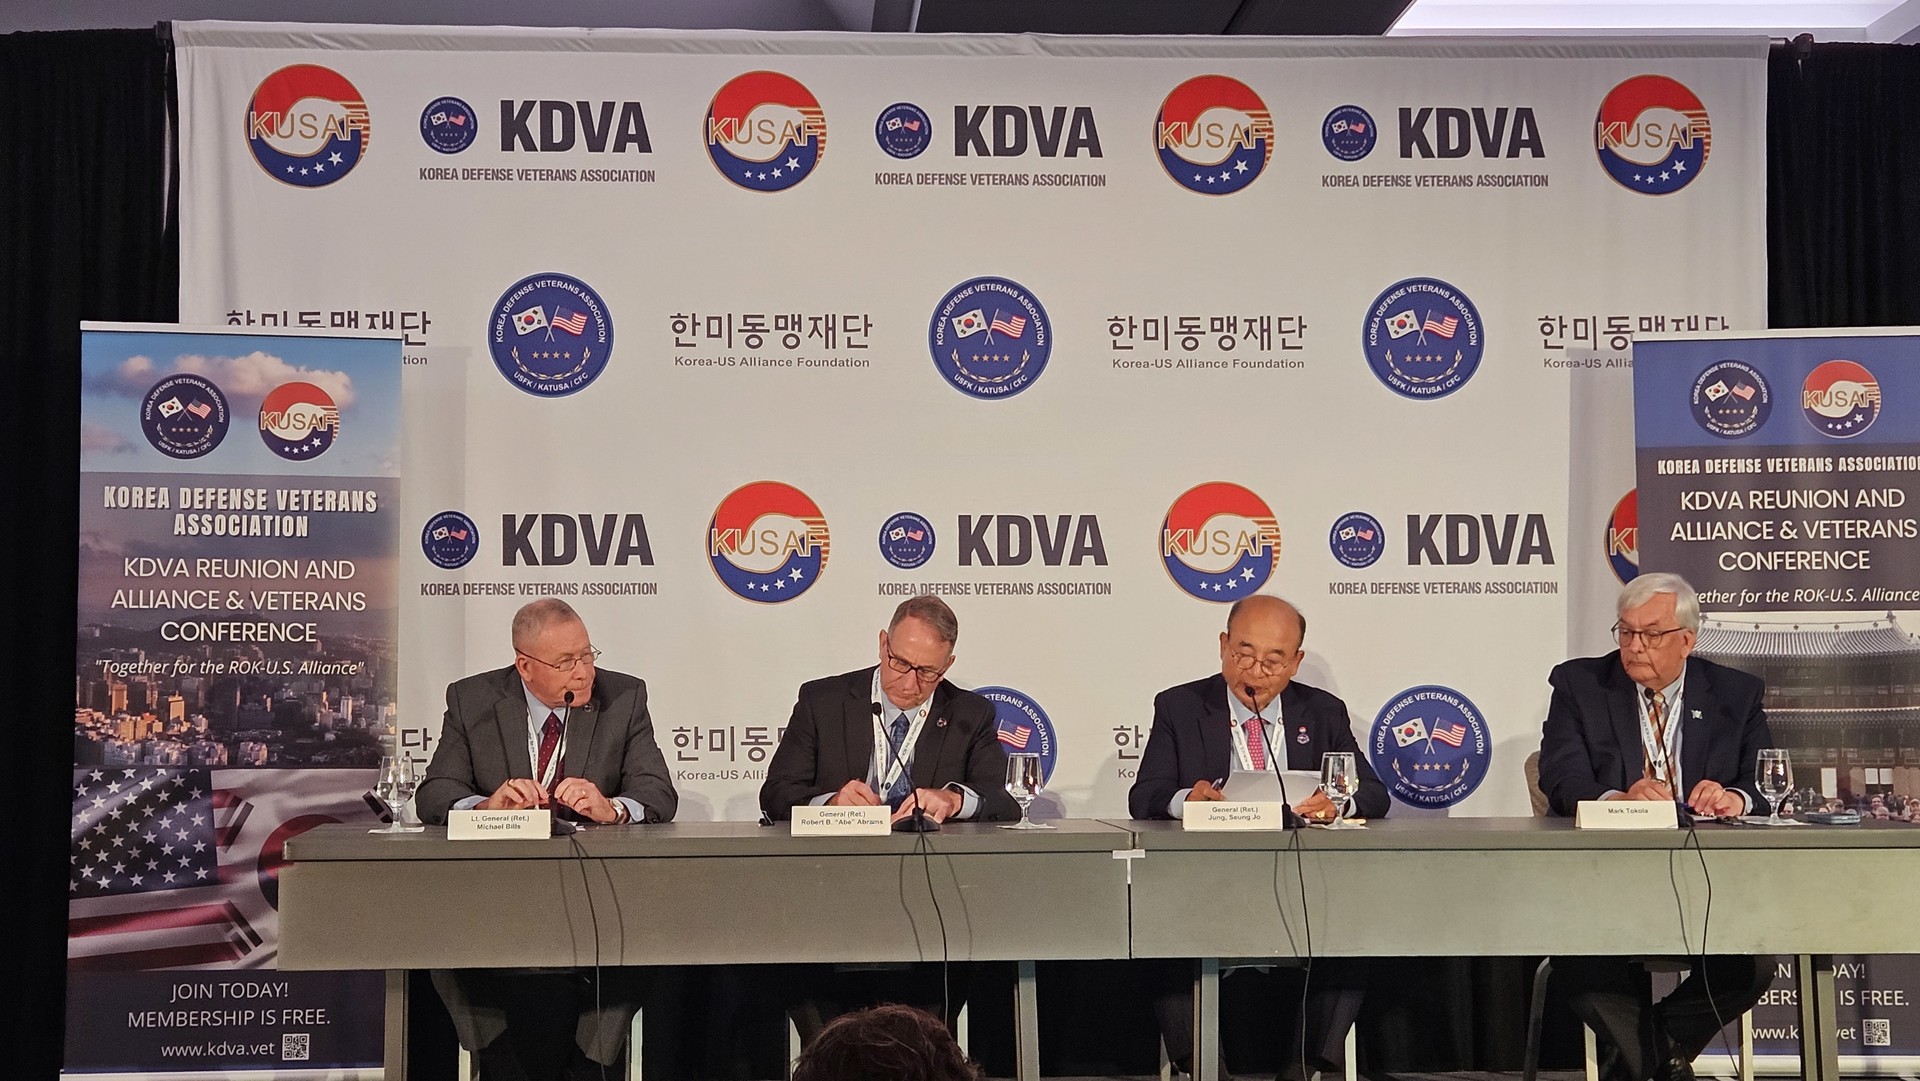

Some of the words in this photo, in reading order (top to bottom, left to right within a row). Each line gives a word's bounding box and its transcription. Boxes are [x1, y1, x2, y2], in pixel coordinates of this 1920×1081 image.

[250, 111, 364, 141] KUSAF
[500, 100, 652, 153] KDVA
[708, 117, 821, 147] KUSAF
[954, 105, 1103, 158] KDVA
[1158, 121, 1268, 150] KUSAF
[1399, 107, 1545, 158] KDVA
[1598, 121, 1706, 150] KUSAF
[420, 168, 459, 180] KOREA
[462, 168, 513, 181] DEFENSE
[516, 169, 577, 181] VETERANS
[580, 169, 655, 182] ASSOCIATION
[875, 173, 913, 185] KOREA
[917, 173, 967, 185] DEFENSE
[970, 173, 1029, 186] VETERANS
[1032, 174, 1106, 187] ASSOCIATION
[1322, 175, 1359, 187] KOREA
[1363, 175, 1412, 187] DEFENSE
[1415, 175, 1473, 187] VETERANS
[1476, 174, 1548, 187] ASSOCIATION
[496, 312, 507, 343] KOREA
[502, 284, 535, 313] DEFENSE
[534, 280, 580, 294] VETERANS
[577, 289, 606, 343] ASSOCIATION
[936, 315, 947, 346] KOREA
[942, 287, 974, 316] DEFENSE
[973, 284, 1018, 298] VETERANS
[1016, 293, 1044, 346] ASSOCIATION
[1370, 316, 1381, 347] KOREA
[1376, 289, 1407, 318] DEFENSE
[1406, 286, 1451, 299] VETERANS
[1448, 295, 1476, 347] ASSOCIATION
[670, 313, 873, 349] 한미동맹재단
[1107, 316, 1307, 351] 한미동맹재단
[675, 356, 736, 366] Korea-US
[739, 357, 792, 367] Alliance
[797, 357, 869, 367] Foundation
[1113, 359, 1172, 368] Korea-US
[1176, 359, 1228, 368] Alliance
[1233, 359, 1304, 368] Foundation
[1544, 358, 1602, 368] Korea-US
[1605, 358, 1633, 368] Allia
[513, 371, 533, 386] USFK
[538, 381, 569, 390] KATUSA
[573, 371, 588, 384] CFC
[953, 373, 972, 388] USFK
[977, 383, 1008, 392] KATUSA
[1011, 373, 1027, 386] CFC
[1387, 375, 1406, 390] USFK
[1410, 385, 1441, 394] KATUSA
[1444, 375, 1459, 388] CFC
[145, 400, 154, 420] KOREA
[150, 381, 173, 401] DEFENSE
[173, 379, 206, 388] VETERANS
[203, 385, 224, 422] ASSOCIATION
[1803, 388, 1877, 409] KUSAF
[260, 411, 338, 432] KUSAF
[157, 440, 171, 451] USFK
[199, 441, 211, 451] CFC
[1658, 459, 1700, 474] KOREA
[1705, 459, 1761, 473] DEFENSE
[1767, 457, 1833, 472] VETERANS
[104, 486, 169, 508] KOREA
[180, 487, 266, 510] DEFENSE
[276, 489, 376, 512] VETERANS
[1681, 491, 1743, 510] KDVA
[1749, 489, 1848, 509] REUNION
[1855, 489, 1905, 508] AND
[174, 514, 307, 537] ASSOCIATION
[1670, 521, 1774, 541] ALLIANCE
[1780, 521, 1798, 539] &
[1803, 519, 1917, 539] VETERANS
[502, 514, 654, 566] KDVA
[712, 528, 824, 558] KUSAF
[958, 515, 1108, 566] KDVA
[1164, 528, 1277, 558] KUSAF
[1407, 514, 1555, 565] KDVA
[125, 558, 190, 577] KDVA
[197, 559, 298, 579] REUNION
[305, 560, 355, 579] AND
[1719, 550, 1870, 571] CONFERENCE
[421, 583, 460, 596] KOREA
[463, 583, 515, 595] DEFENSE
[518, 583, 578, 595] VETERANS
[582, 583, 657, 595] ASSOCIATION
[879, 583, 918, 595] KOREA
[920, 583, 971, 595] DEFENSE
[974, 583, 1034, 595] VETERANS
[1037, 583, 1111, 595] ASSOCIATION
[1329, 582, 1367, 594] KOREA
[1371, 582, 1420, 594] DEFENSE
[1423, 582, 1482, 594] VETERANS
[1485, 581, 1558, 594] ASSOCIATION
[1695, 589, 1735, 603] ether
[1738, 589, 1762, 606] for
[1766, 589, 1789, 602] the
[1794, 588, 1857, 602] ROK-U.S.
[111, 589, 220, 609] ALLIANCE
[226, 590, 244, 609] &
[250, 591, 366, 611] VETERANS
[161, 621, 317, 642] CONFERENCE
[95, 659, 169, 677] "Together
[170, 660, 196, 677] for
[200, 660, 224, 674] the
[228, 660, 294, 674] ROK-U.S.
[298, 660, 364, 675] Alliance"
[983, 693, 1023, 708] ETERANS
[1021, 705, 1049, 756] ASSOCIATION
[1376, 724, 1387, 755] KOREA
[1382, 696, 1414, 725] DEFENSE
[1413, 693, 1458, 706] VETERANS
[1456, 702, 1484, 755] ASSOCIATION
[742, 770, 768, 780] Alli
[1393, 782, 1412, 798] USFK
[1417, 793, 1448, 802] KATUSA
[1451, 783, 1466, 796] CFC
[170, 984, 212, 1003] JOIN
[219, 982, 288, 998] TODAY!
[1840, 990, 1855, 1005] IS
[1862, 990, 1909, 1006] FREE.
[129, 1010, 254, 1027] MEMBERSHIP
[261, 1010, 276, 1025] IS
[283, 1009, 330, 1025] FREE.
[161, 1041, 275, 1056] www.kdva.vet
